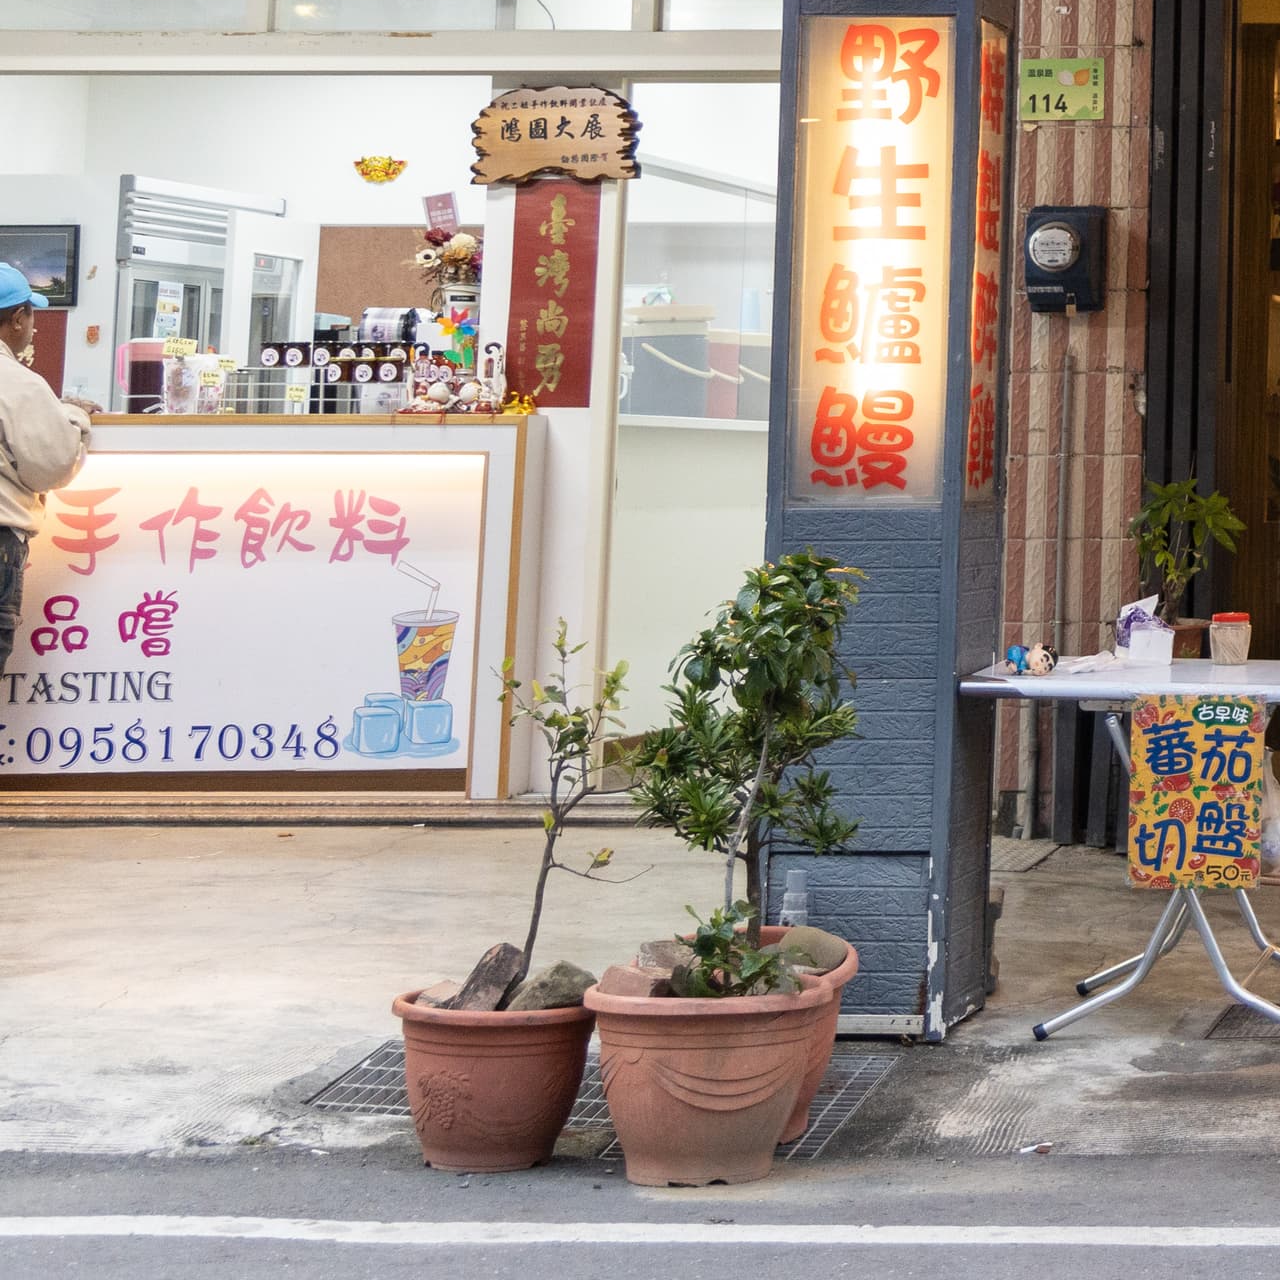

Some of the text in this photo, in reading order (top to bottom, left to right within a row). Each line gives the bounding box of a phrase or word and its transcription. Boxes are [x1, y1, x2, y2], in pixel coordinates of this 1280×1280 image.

[500, 113, 606, 143] 鴻圖大展
[1028, 93, 1068, 113] 114
[809, 23, 941, 493] 野生鱸鰻
[51, 487, 411, 577] 手作飲料
[0, 670, 175, 704] TASTING
[1197, 703, 1250, 724] 古早味
[1141, 718, 1256, 785] 蕃茄
[1134, 800, 1251, 872] 切盤
